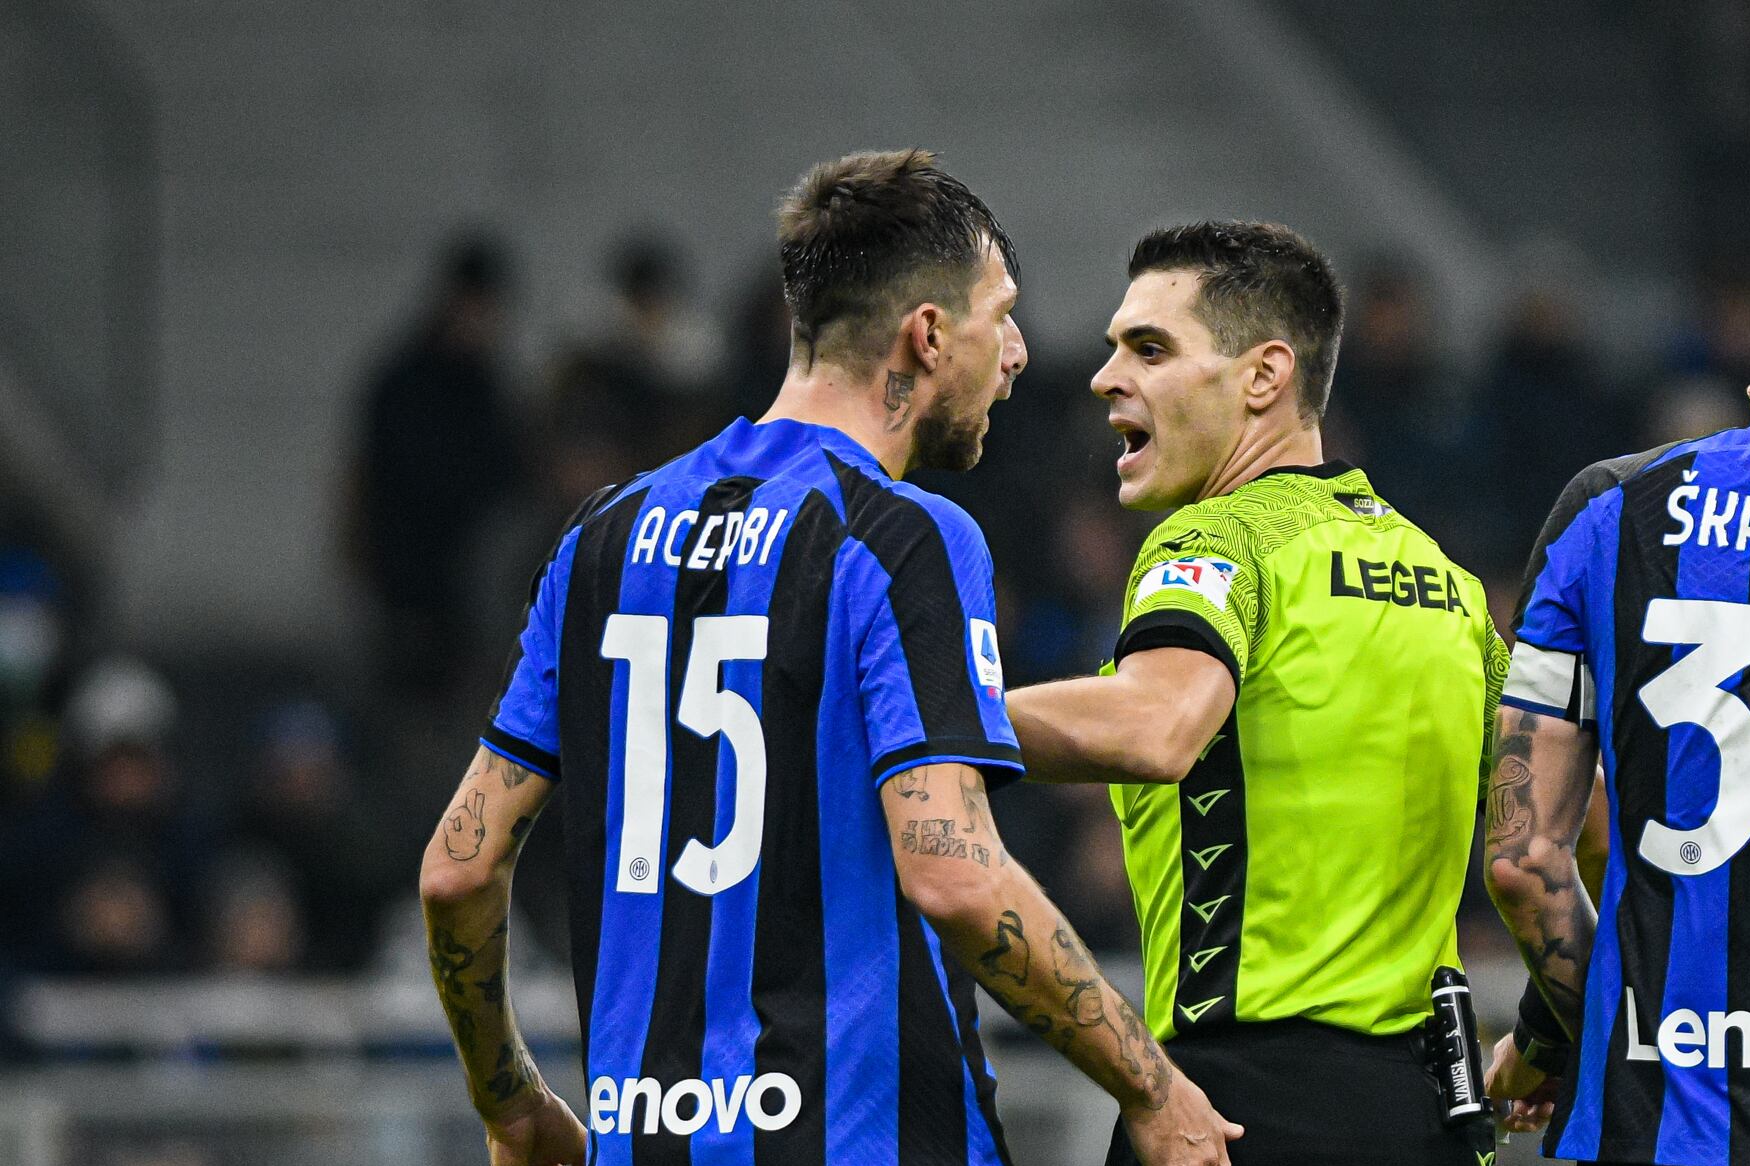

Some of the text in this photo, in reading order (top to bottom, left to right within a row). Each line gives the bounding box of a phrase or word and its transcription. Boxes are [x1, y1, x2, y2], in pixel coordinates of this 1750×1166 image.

[631, 506, 789, 570] ACERBI
[1331, 551, 1470, 617] LEGEA
[600, 613, 770, 896] 15
